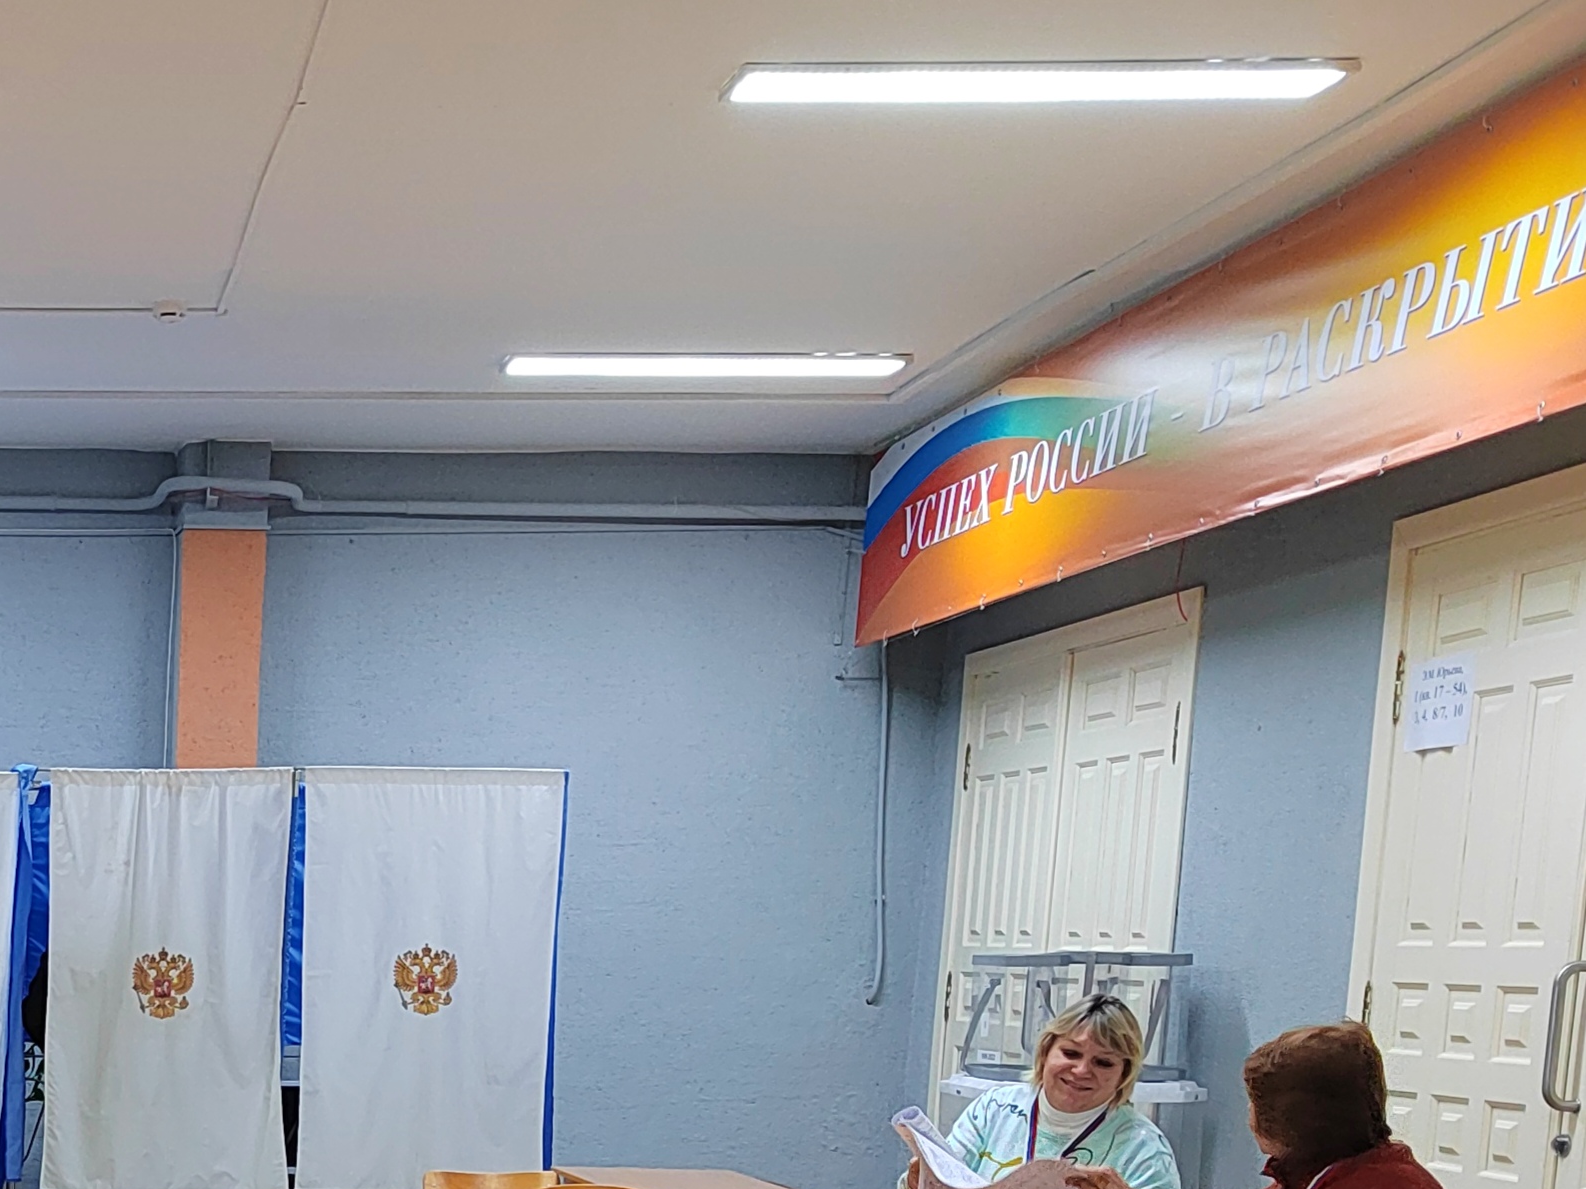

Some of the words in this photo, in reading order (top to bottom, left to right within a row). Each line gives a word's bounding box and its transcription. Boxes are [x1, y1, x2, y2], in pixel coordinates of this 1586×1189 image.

[900, 462, 999, 559] УСПЕХ
[1001, 387, 1159, 516] РОССИИ
[1198, 358, 1236, 434] В
